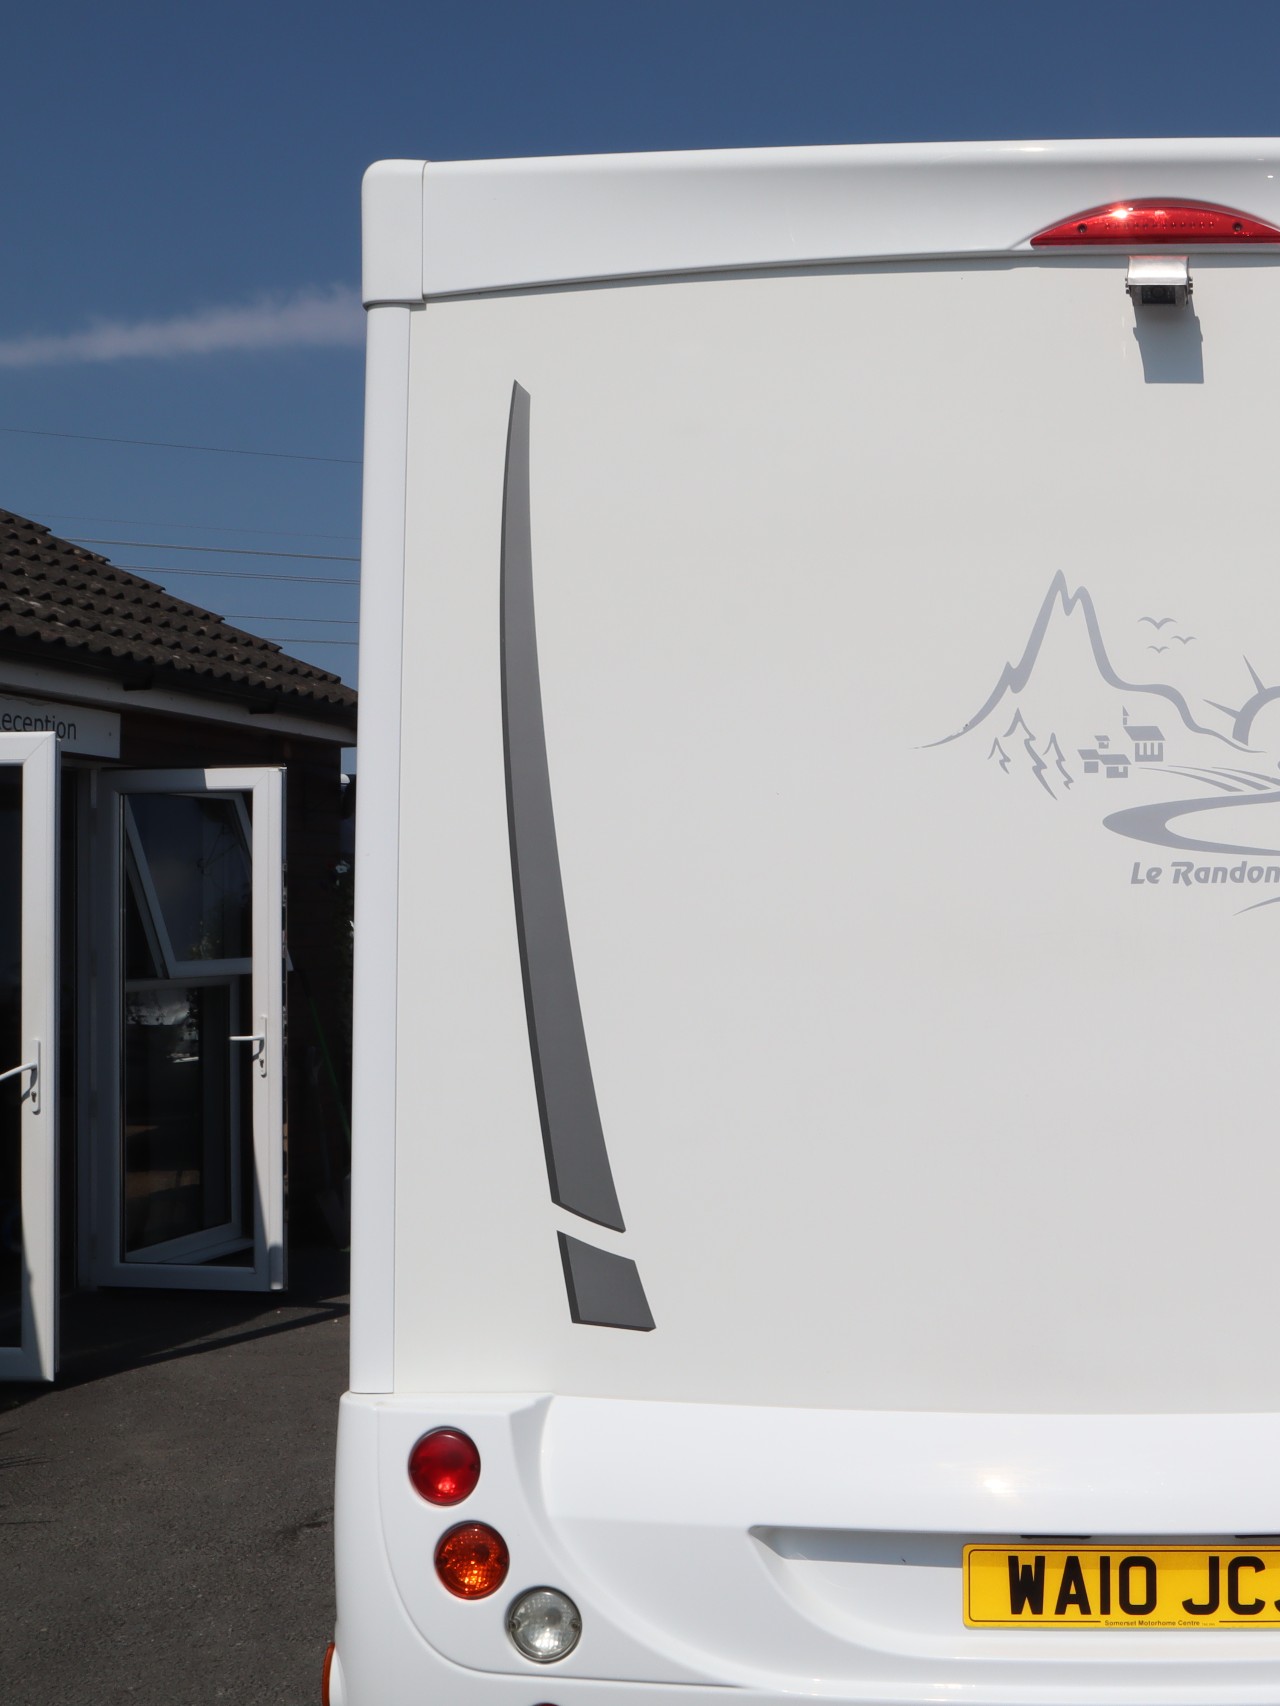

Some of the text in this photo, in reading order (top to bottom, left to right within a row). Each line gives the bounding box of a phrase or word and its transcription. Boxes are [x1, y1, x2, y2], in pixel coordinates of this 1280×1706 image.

[0, 713, 77, 740] eception
[1130, 861, 1163, 885] Le
[1007, 1555, 1158, 1616] WA10
[1104, 1619, 1137, 1627] Somerset
[1138, 1619, 1177, 1627] Motorhome
